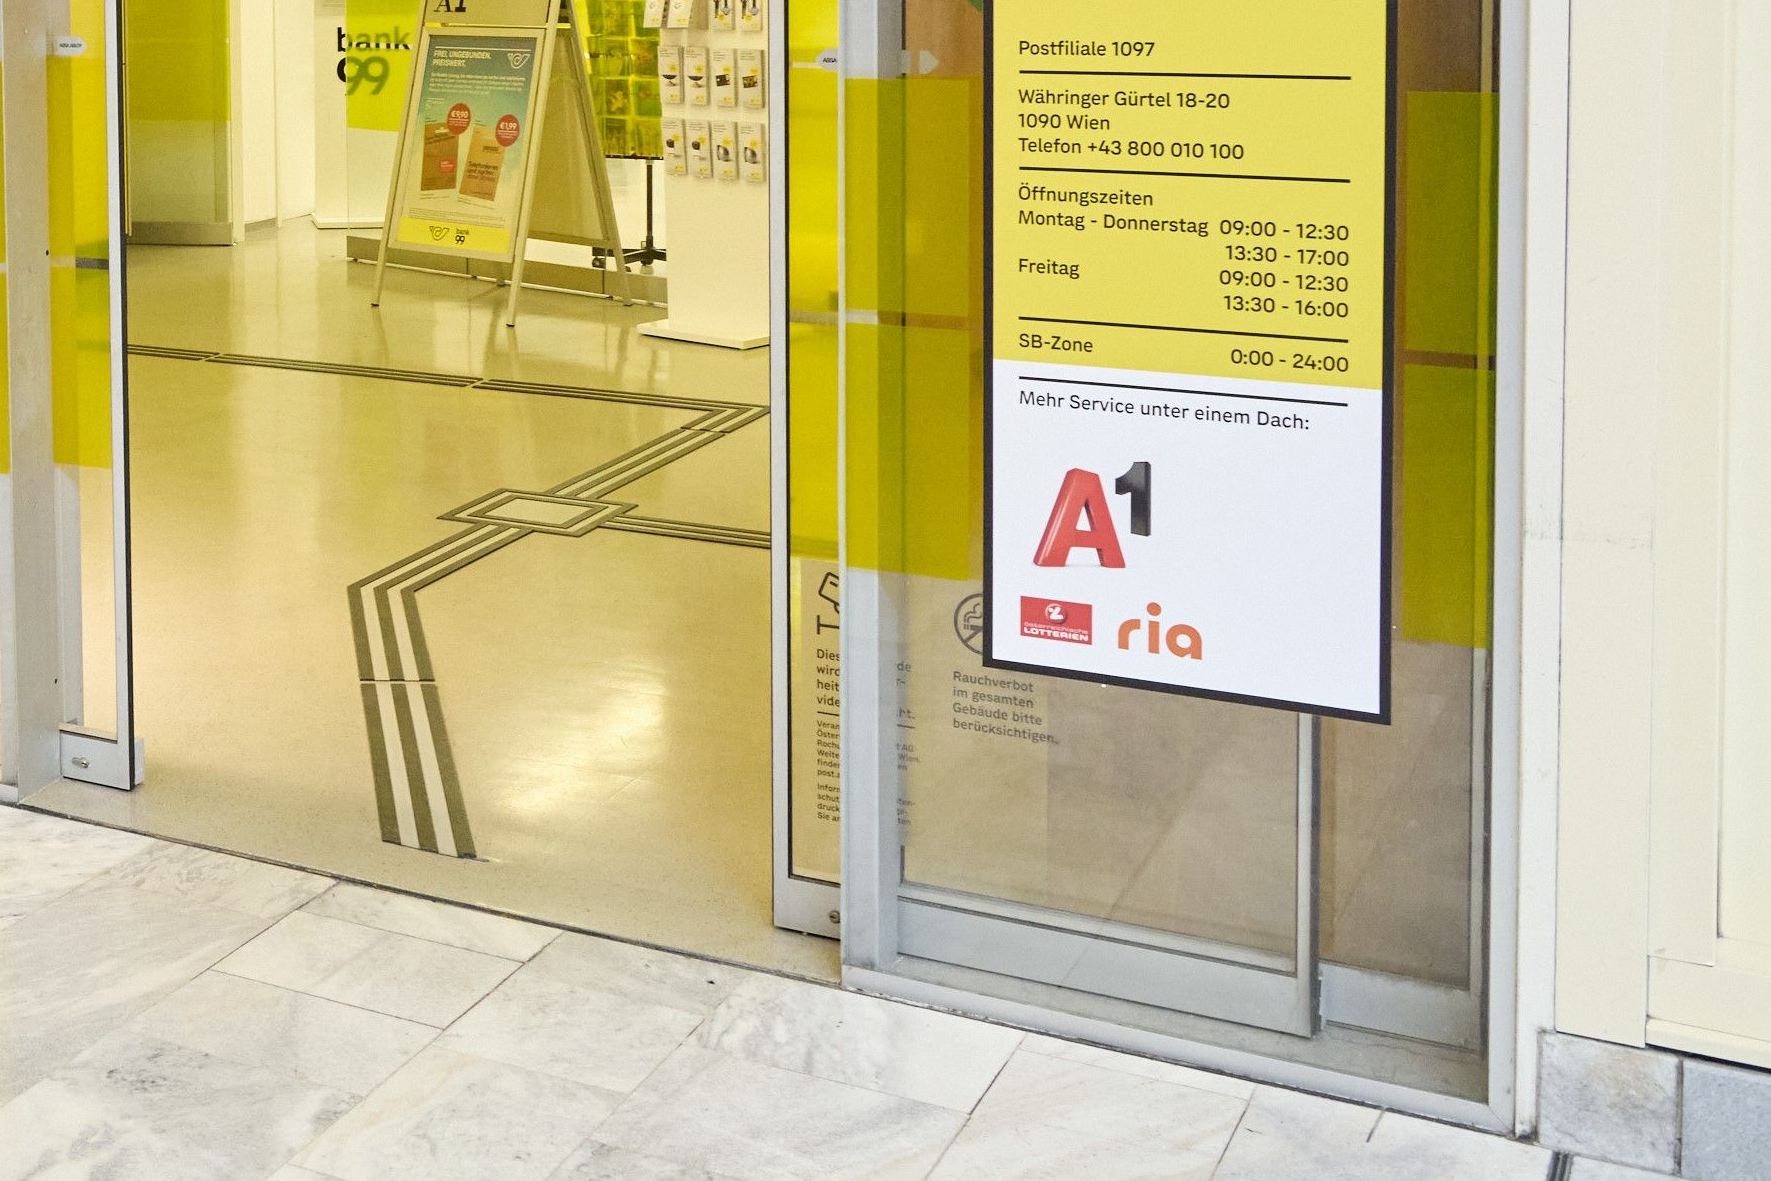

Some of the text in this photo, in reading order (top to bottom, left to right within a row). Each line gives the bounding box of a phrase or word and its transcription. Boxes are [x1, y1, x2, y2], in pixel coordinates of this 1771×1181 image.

[337, 26, 411, 53] bank
[1019, 40, 1155, 57] Postfiliale 1097
[337, 56, 390, 96] 99
[1019, 89, 1230, 109] Währinger Gürtel 18-20
[1018, 113, 1110, 130] 1090 Wien
[1018, 137, 1245, 160] Telefon +43 800 010 100
[1018, 182, 1154, 207] Öffnungszeiten
[1018, 210, 1085, 231] Montag
[1103, 214, 1209, 238] Donnerstag
[1220, 219, 1276, 237] 09:00
[1296, 223, 1349, 241] 12:30
[1226, 245, 1277, 262] 13:30
[1297, 249, 1349, 266] 17:00
[1018, 258, 1080, 280] Freitag
[1219, 270, 1276, 288] 09:00
[1295, 274, 1349, 292] 12:30
[1224, 295, 1275, 313] 13:30
[1295, 300, 1349, 318] 16:00
[1019, 333, 1093, 353] SB-Zone
[1231, 349, 1274, 367] 0:00
[1292, 353, 1349, 372] 24:00
[1019, 390, 1310, 430] Mehr Service unter einem Dach:
[1033, 461, 1151, 568] A1
[1024, 626, 1089, 642] LOTTERIEN
[1118, 602, 1203, 660] ria
[953, 671, 1034, 693] Rauchverbot
[953, 686, 1034, 709] im gesamten
[953, 702, 1043, 726] Gebäude bitte
[953, 718, 1060, 744] berücksichtigen.
